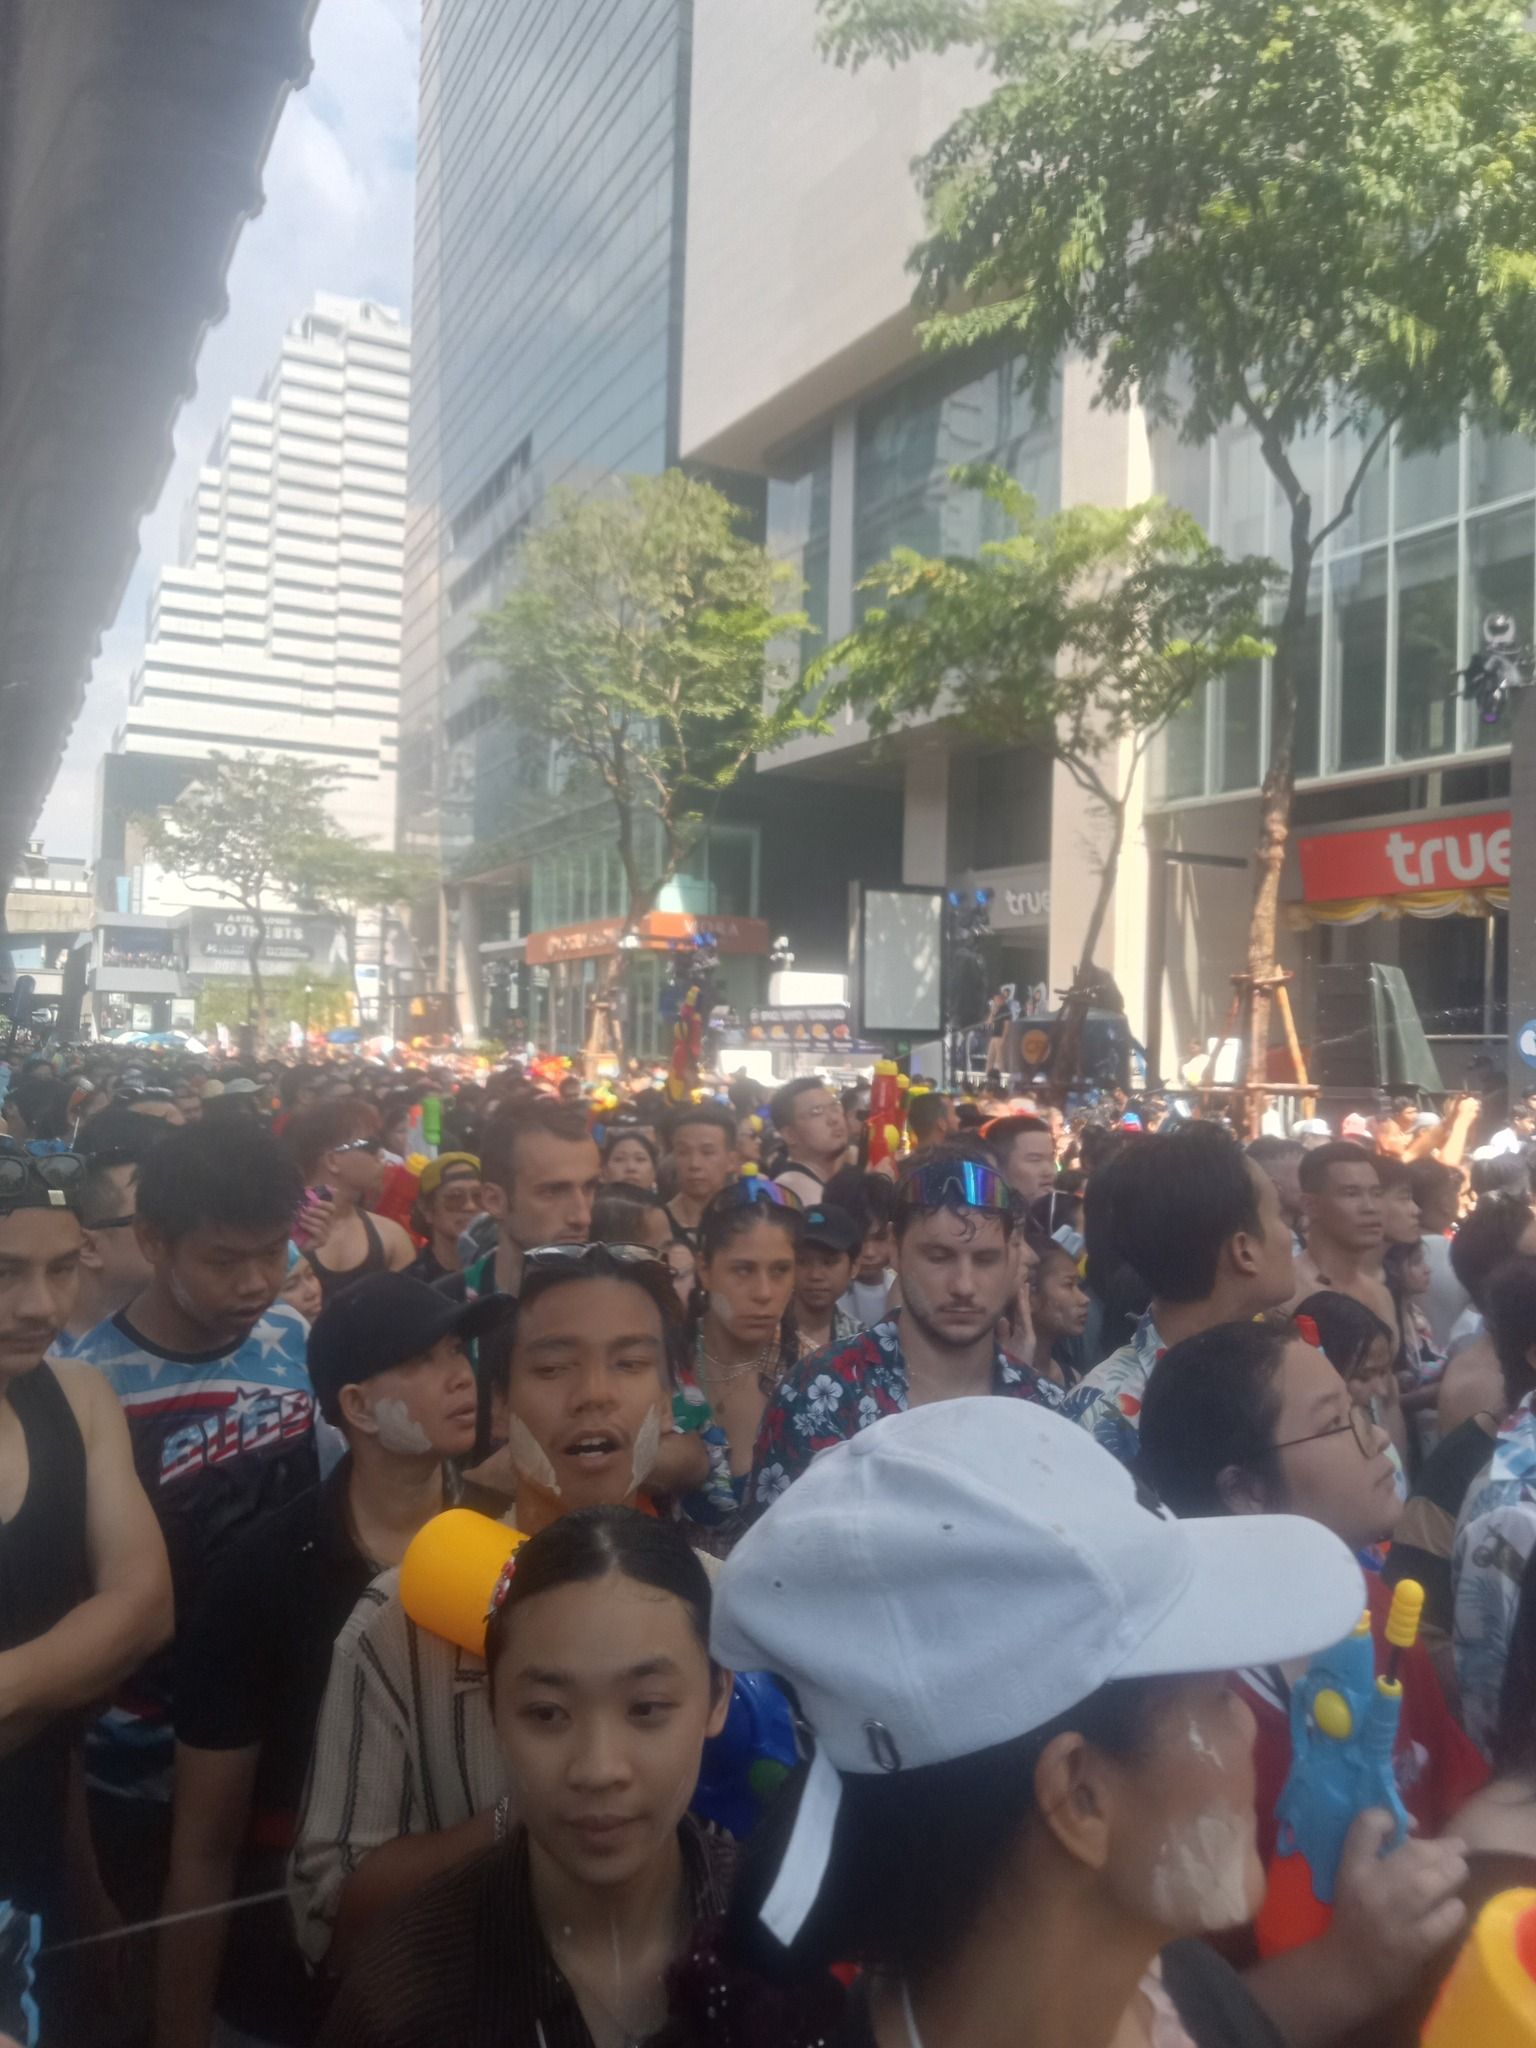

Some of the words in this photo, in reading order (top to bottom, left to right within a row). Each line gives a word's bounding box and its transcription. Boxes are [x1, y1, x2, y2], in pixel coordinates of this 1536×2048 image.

[1385, 828, 1511, 887] true
[1005, 889, 1051, 916] true
[213, 922, 237, 937] TO
[272, 926, 304, 941] BTS
